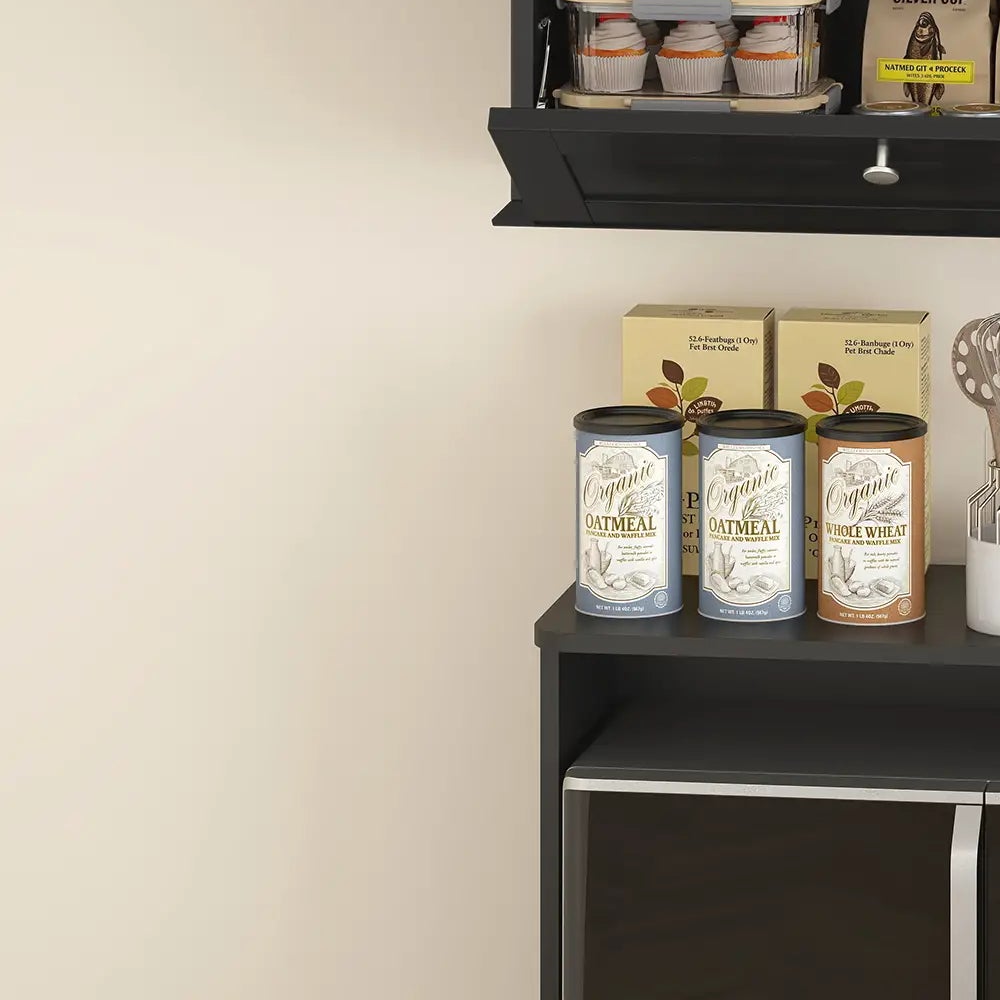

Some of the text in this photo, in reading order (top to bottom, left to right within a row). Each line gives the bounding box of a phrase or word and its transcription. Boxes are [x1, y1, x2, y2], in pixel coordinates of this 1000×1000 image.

[583, 460, 655, 513] Organic
[706, 463, 778, 516] Organic
[826, 466, 898, 521] Organic
[585, 513, 657, 532] OATMEAL
[709, 516, 781, 535] OATMEAL
[825, 521, 907, 539] WHOLE WHEAT
